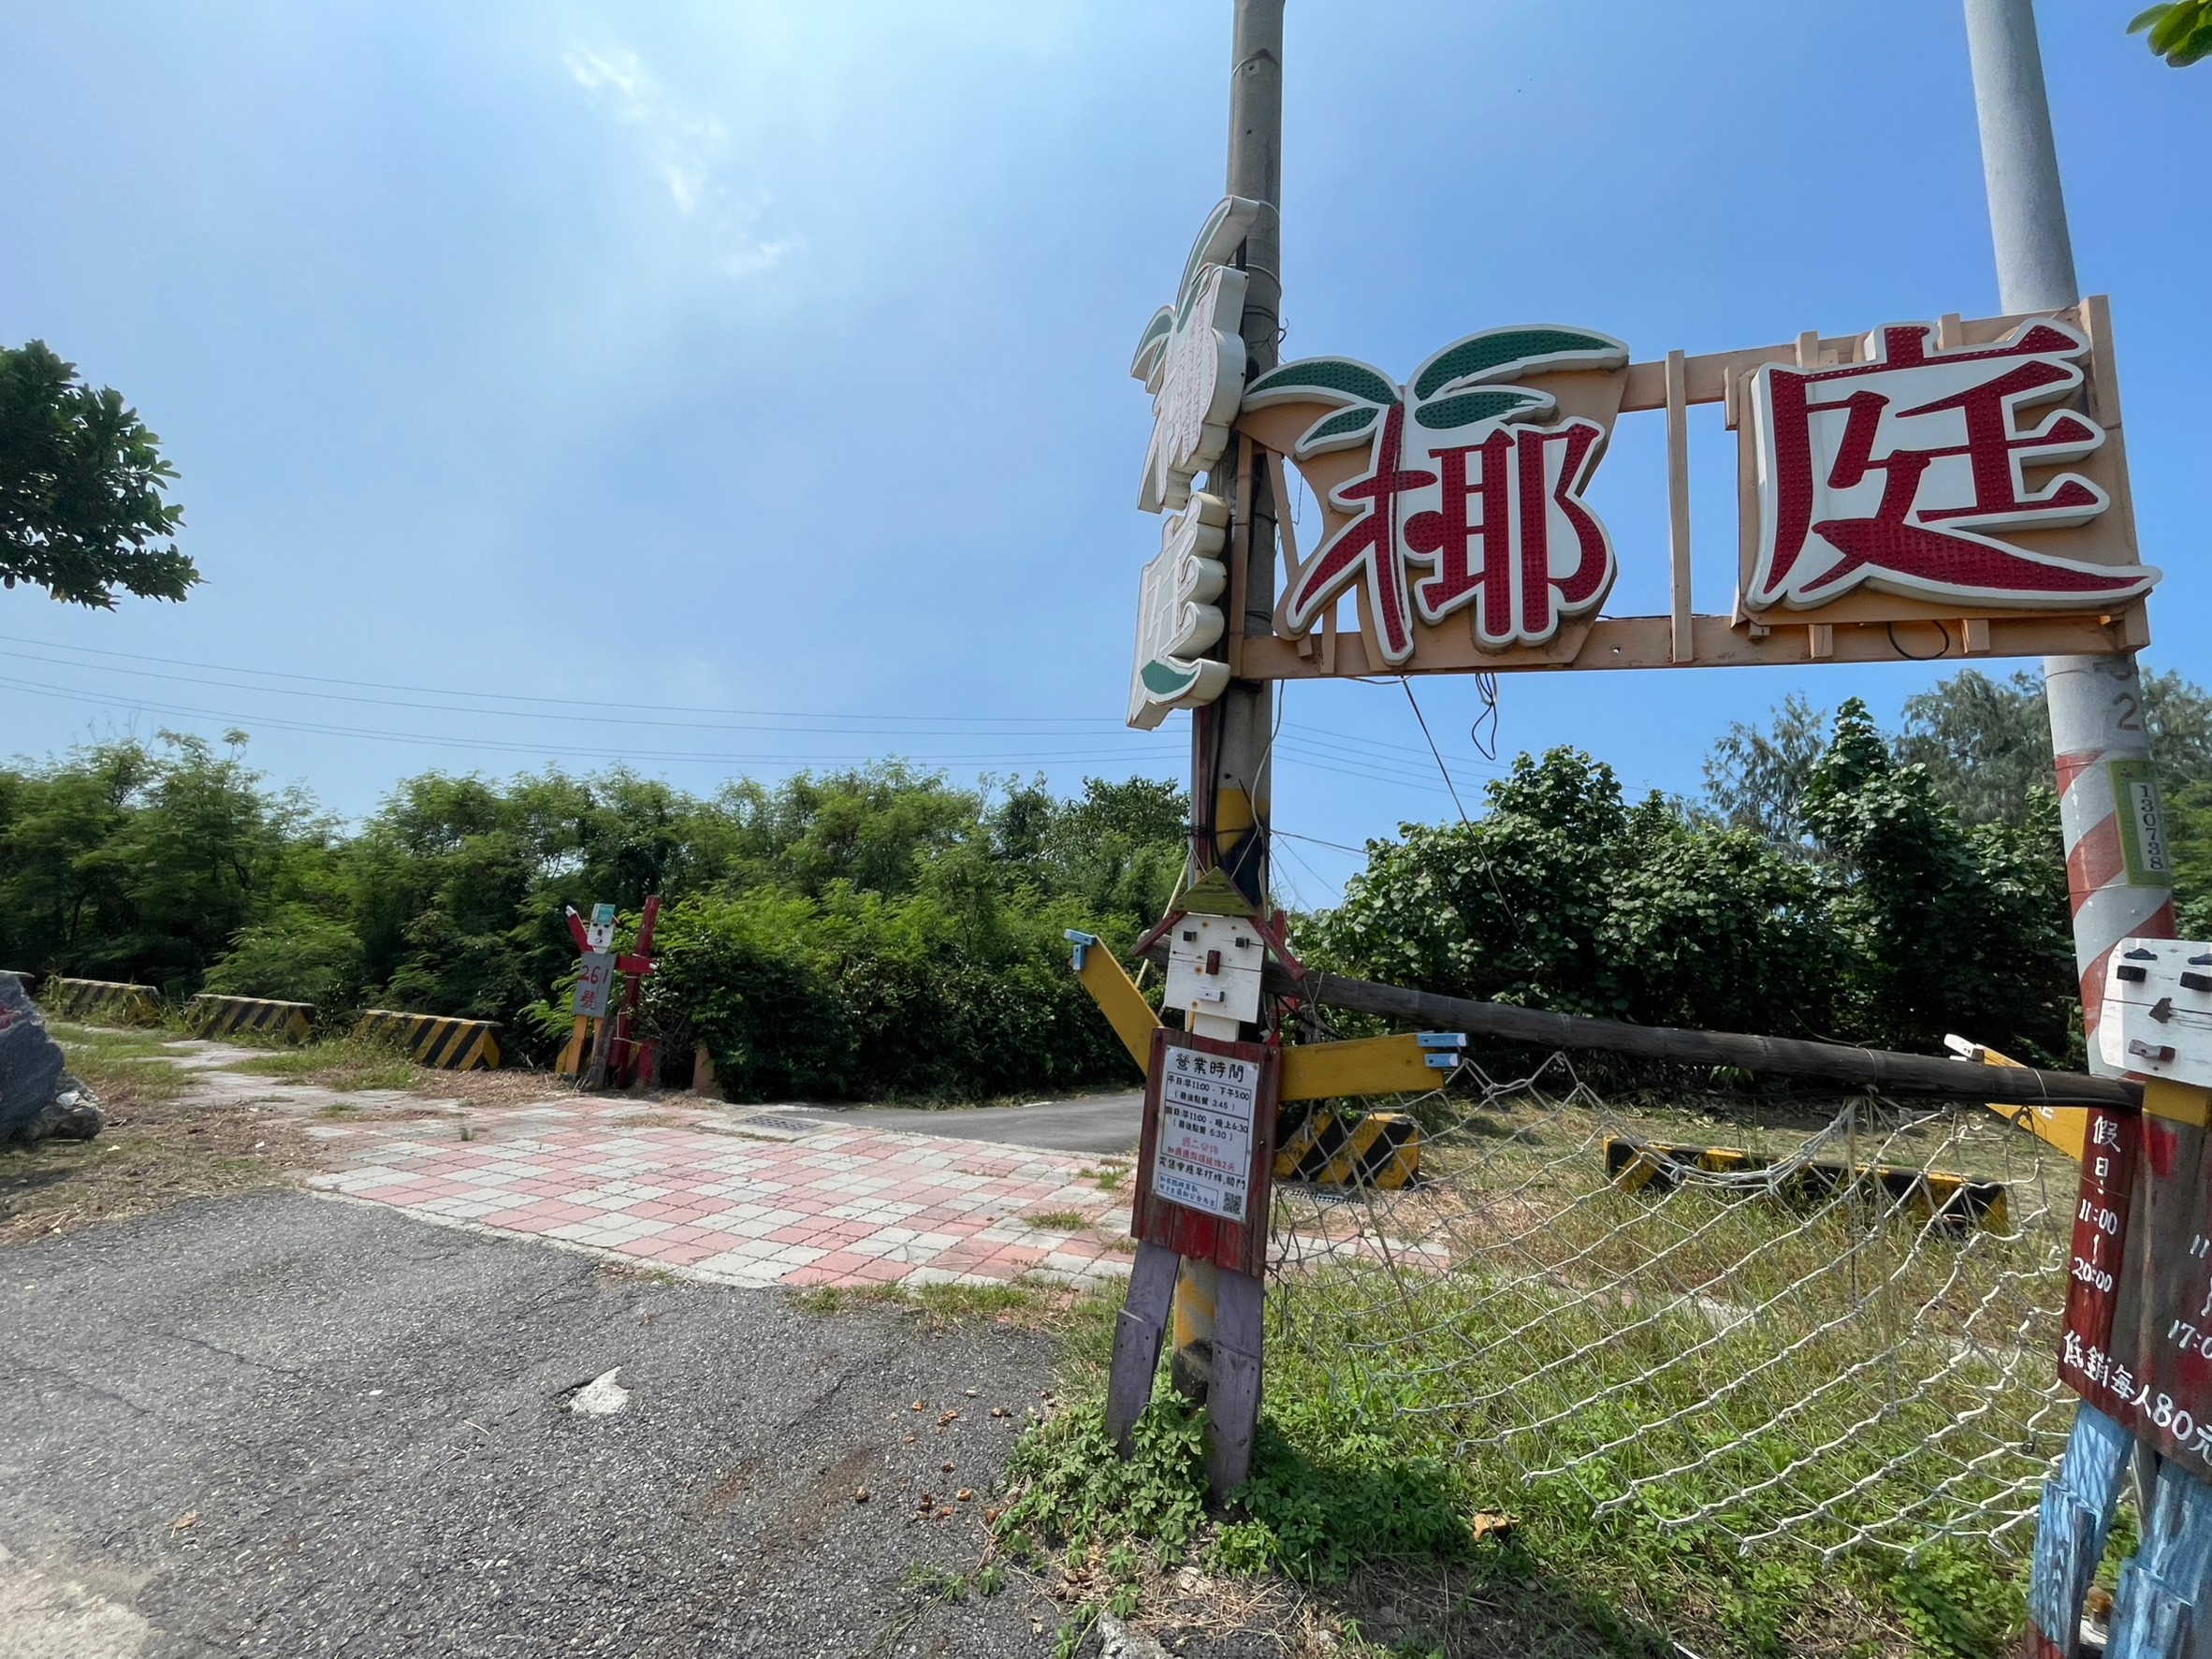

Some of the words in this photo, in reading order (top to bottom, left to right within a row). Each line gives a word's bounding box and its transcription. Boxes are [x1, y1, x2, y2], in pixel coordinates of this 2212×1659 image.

[1263, 325, 2157, 661] 椰庭
[2140, 785, 2163, 870] 130738
[579, 965, 609, 984] 261
[580, 990, 596, 1010] 號
[1175, 1053, 1244, 1083] 營業時間
[2078, 1199, 2117, 1235] 11:00
[2072, 1257, 2113, 1293] 20:00
